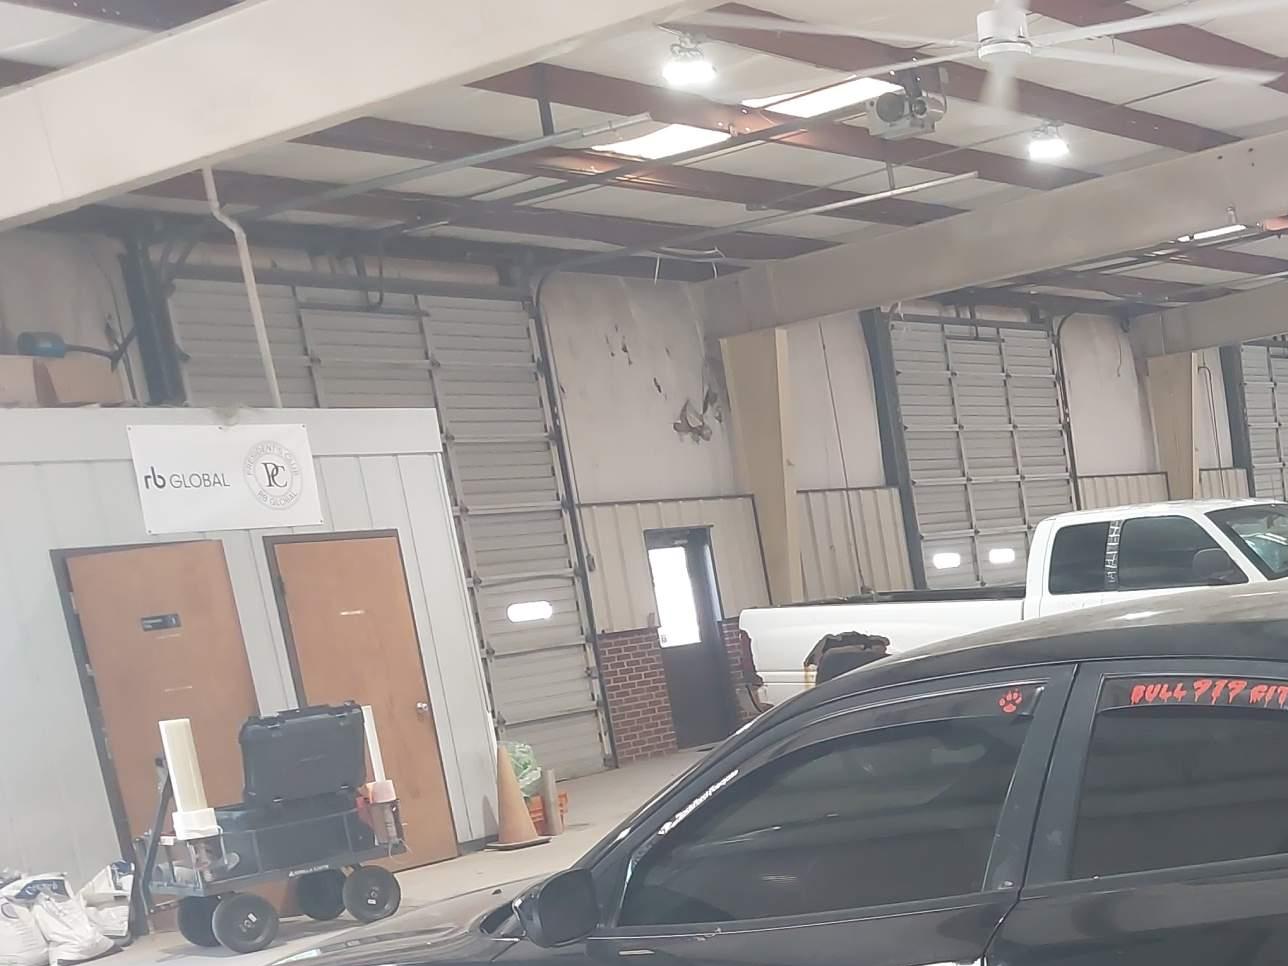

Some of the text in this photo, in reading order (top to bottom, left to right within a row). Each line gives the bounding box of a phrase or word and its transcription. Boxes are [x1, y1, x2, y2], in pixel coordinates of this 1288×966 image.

[144, 466, 231, 490] rb GLOBAL
[1130, 682, 1187, 705] BULL
